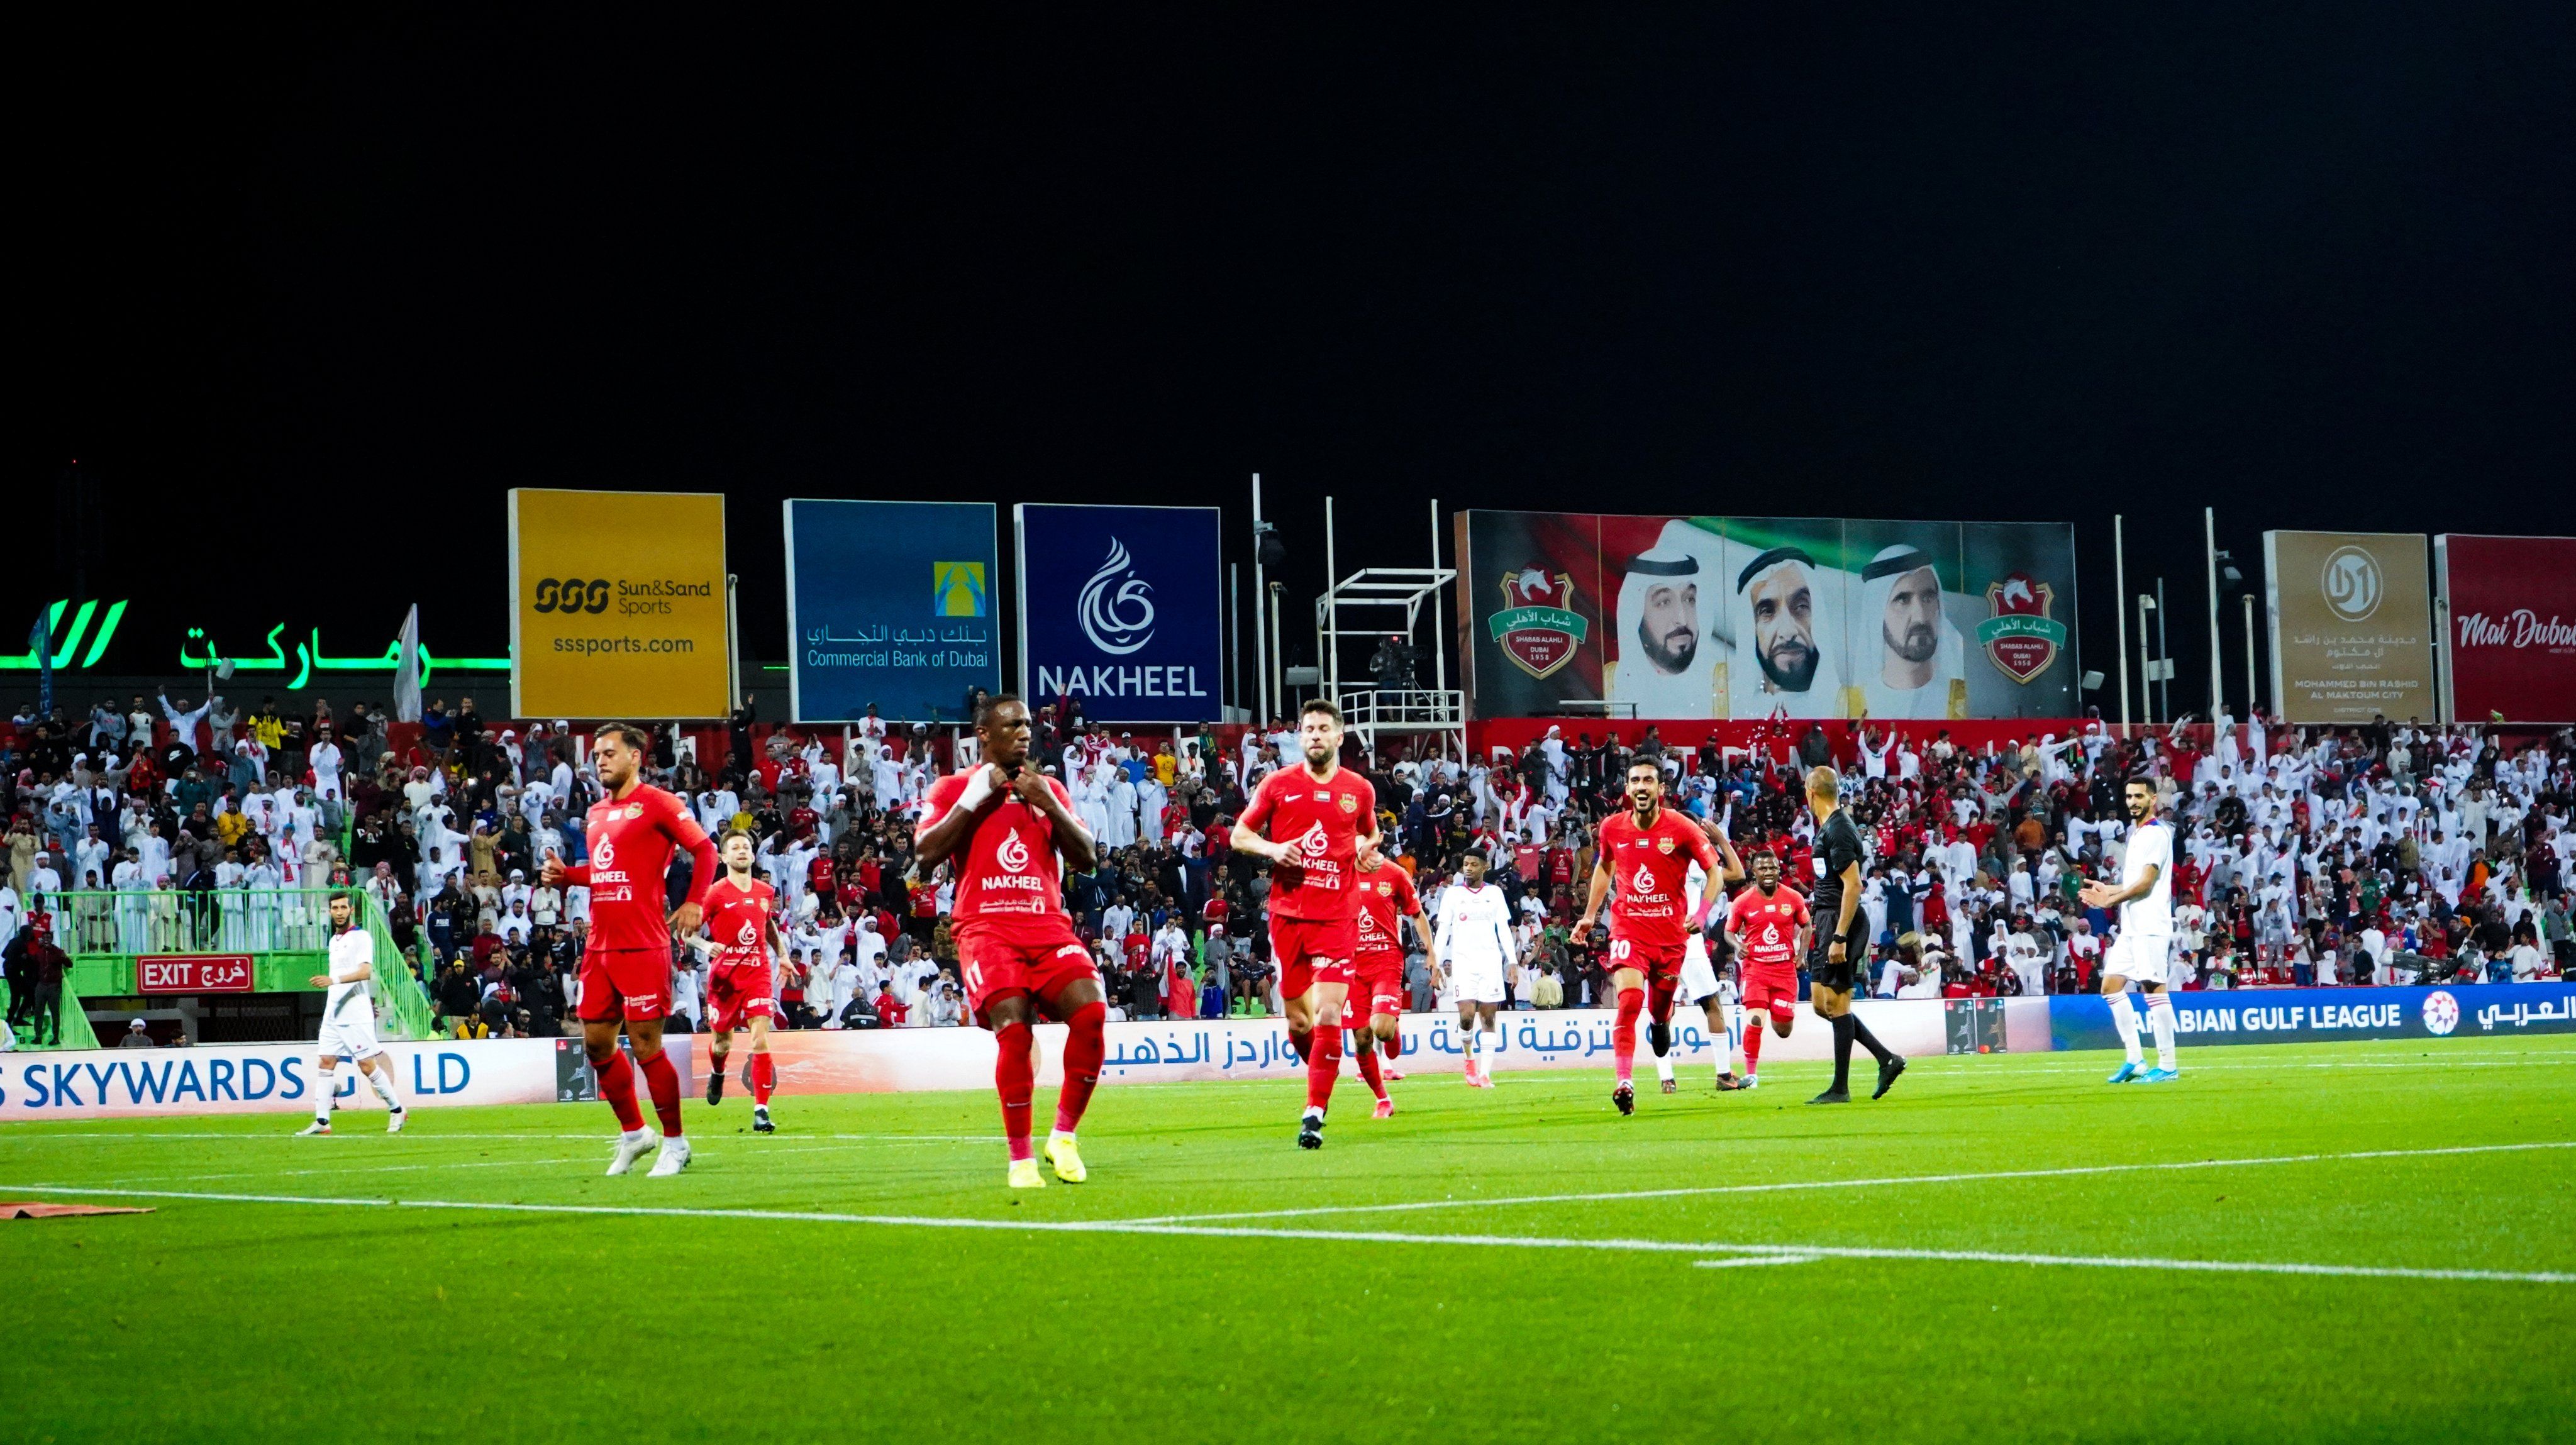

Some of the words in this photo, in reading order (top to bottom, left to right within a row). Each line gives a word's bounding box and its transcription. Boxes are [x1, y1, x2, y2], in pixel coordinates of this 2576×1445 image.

[618, 580, 711, 597] Sun&Sand
[619, 599, 672, 617] Sports
[1506, 610, 1538, 630] الأهلي
[1540, 613, 1571, 626] شباب
[807, 624, 888, 646] التجاري
[893, 628, 936, 646] دبي
[941, 624, 987, 646] بنك
[2457, 612, 2511, 648] Mai
[553, 636, 694, 656] sssports.com
[808, 650, 888, 667] Commercial
[893, 650, 928, 667] Bank
[932, 650, 946, 667] of
[950, 650, 988, 667] Dubai
[1039, 665, 1208, 697] NAKHEEL
[2295, 680, 2357, 689] MOHAMMED
[2359, 680, 2377, 689] BIN
[2379, 680, 2419, 689] RASHID
[2311, 691, 2324, 699] AL
[2326, 691, 2379, 699] MAKTOUM
[2382, 691, 2404, 699] CITY
[1299, 857, 1340, 873] KHEEL
[590, 870, 630, 884] AKHEEL
[981, 875, 1043, 891] NAKHEEL
[1626, 893, 1670, 904] NAKHEEL
[1358, 931, 1387, 942] KHEEL
[1610, 939, 1631, 960] 20
[1754, 943, 1788, 953] NAKHEEL
[145, 963, 192, 985] EXIT
[201, 960, 245, 987] خروج
[2242, 1007, 2304, 1031] GULF
[2311, 1004, 2401, 1029] LEAGUE
[2478, 995, 2576, 1031] العربي
[24, 1057, 306, 1108] SKYWARDS
[333, 1053, 470, 1097] GLD
